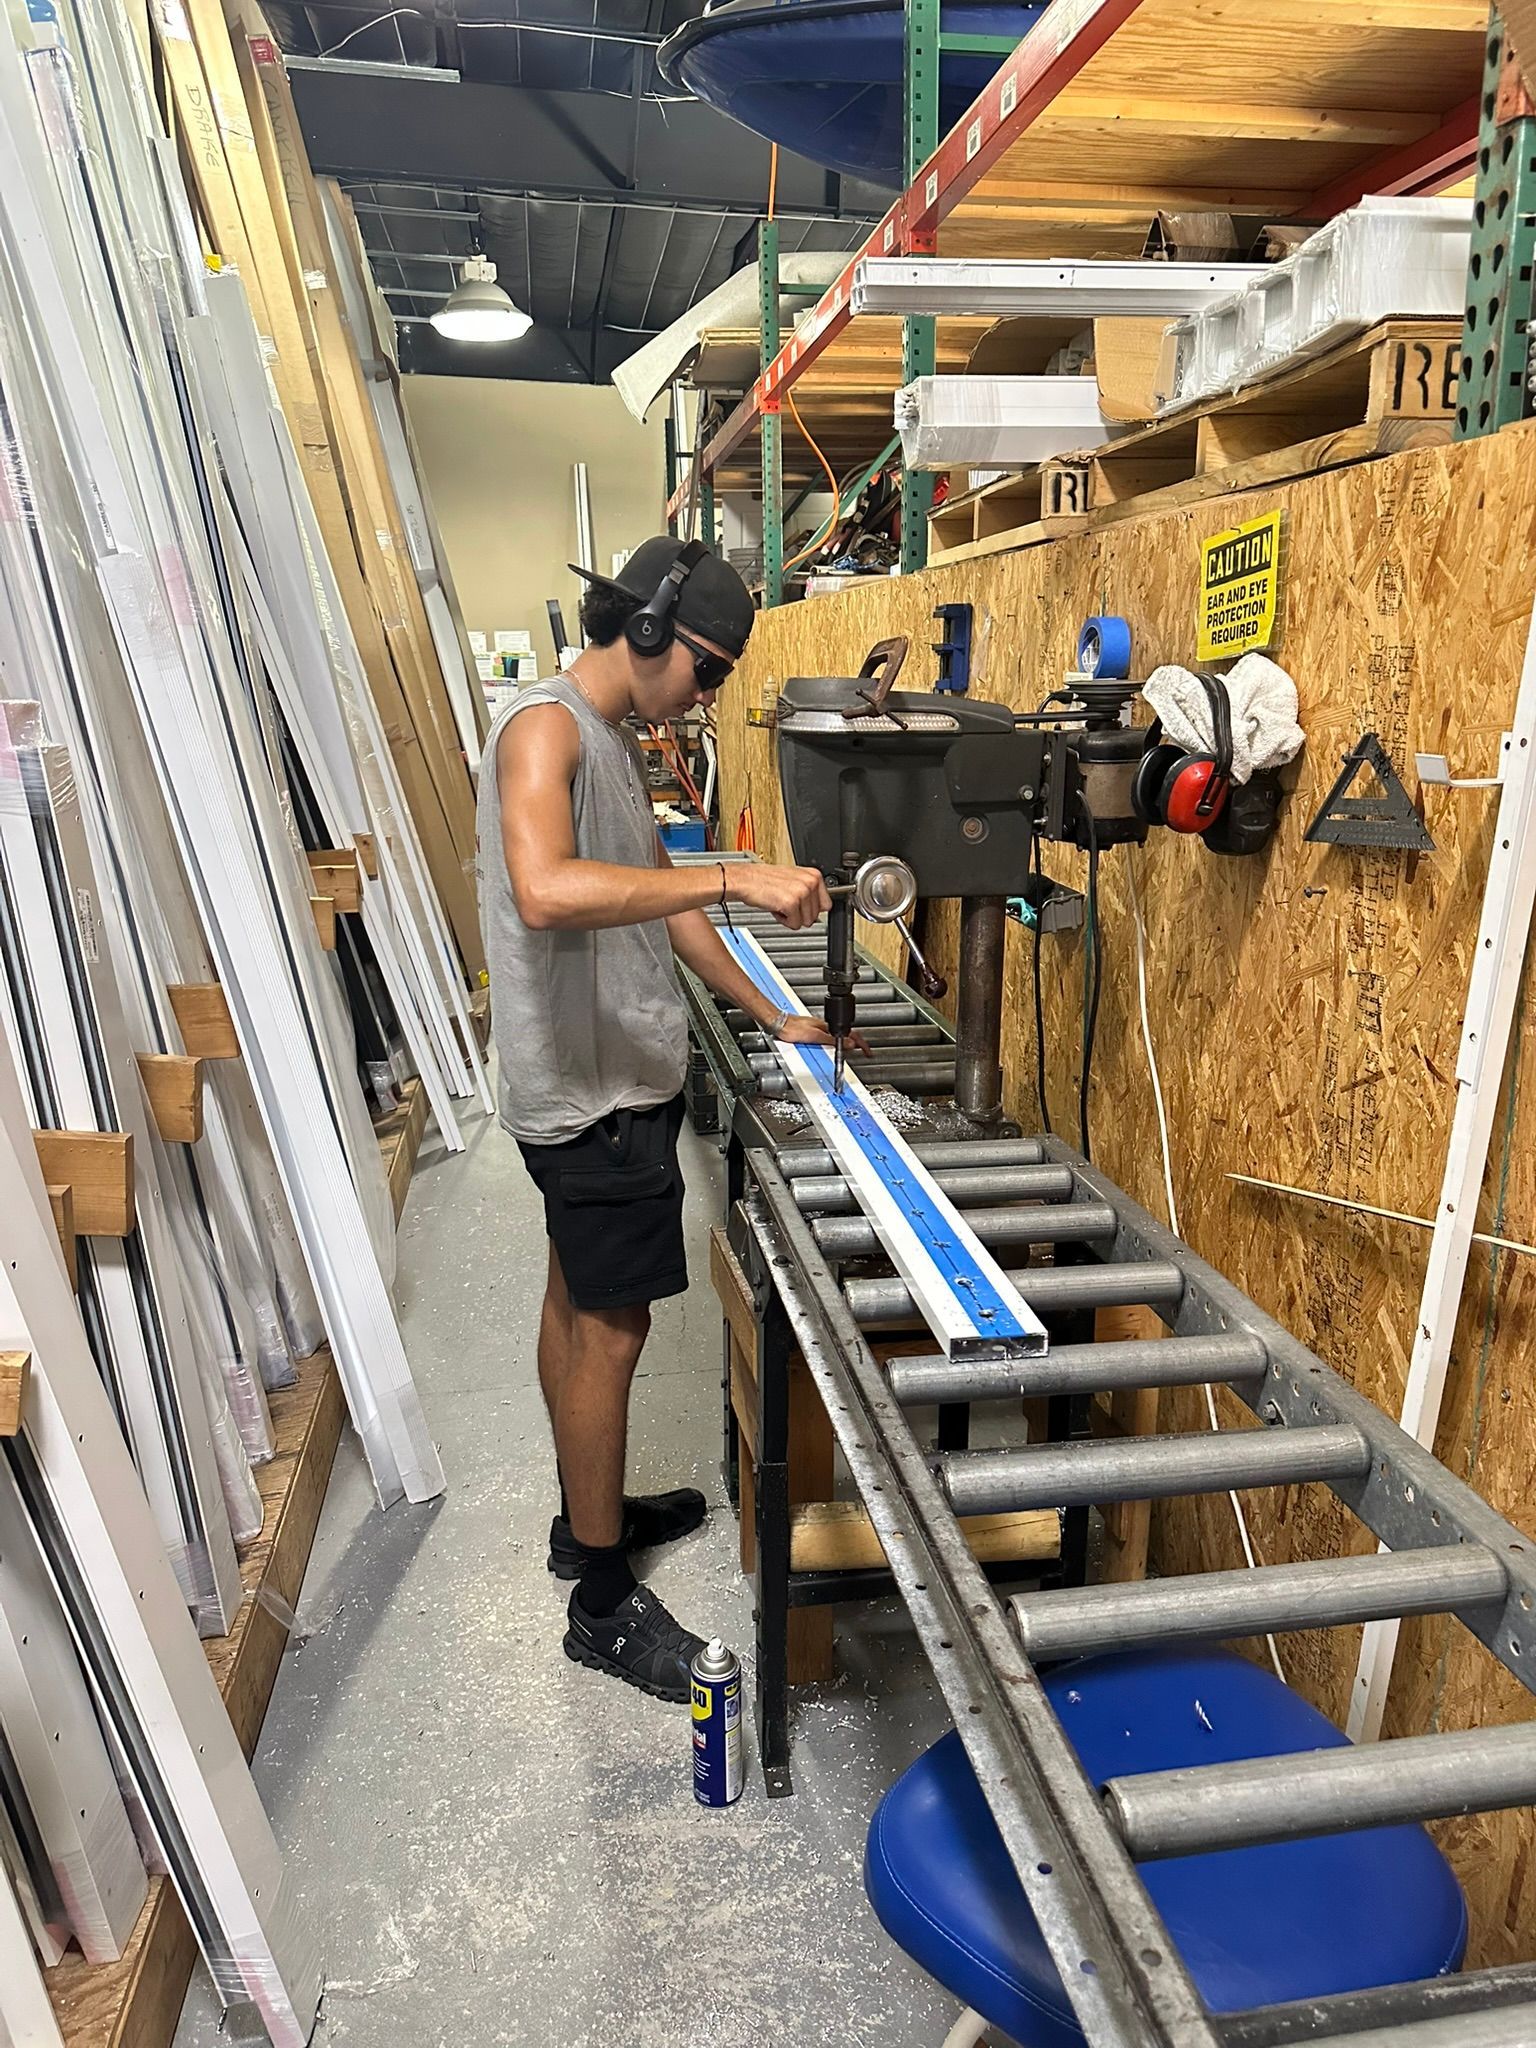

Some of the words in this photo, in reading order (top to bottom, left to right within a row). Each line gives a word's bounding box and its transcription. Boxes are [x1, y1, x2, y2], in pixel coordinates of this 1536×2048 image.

[185, 84, 220, 168] DRAKE
[1207, 531, 1272, 583] CAUTION
[1207, 591, 1225, 611] EAR
[1226, 585, 1246, 605] AND
[1249, 577, 1268, 598] EYE
[1206, 598, 1266, 629] PROTECTION
[1211, 620, 1258, 645] REQUIRED
